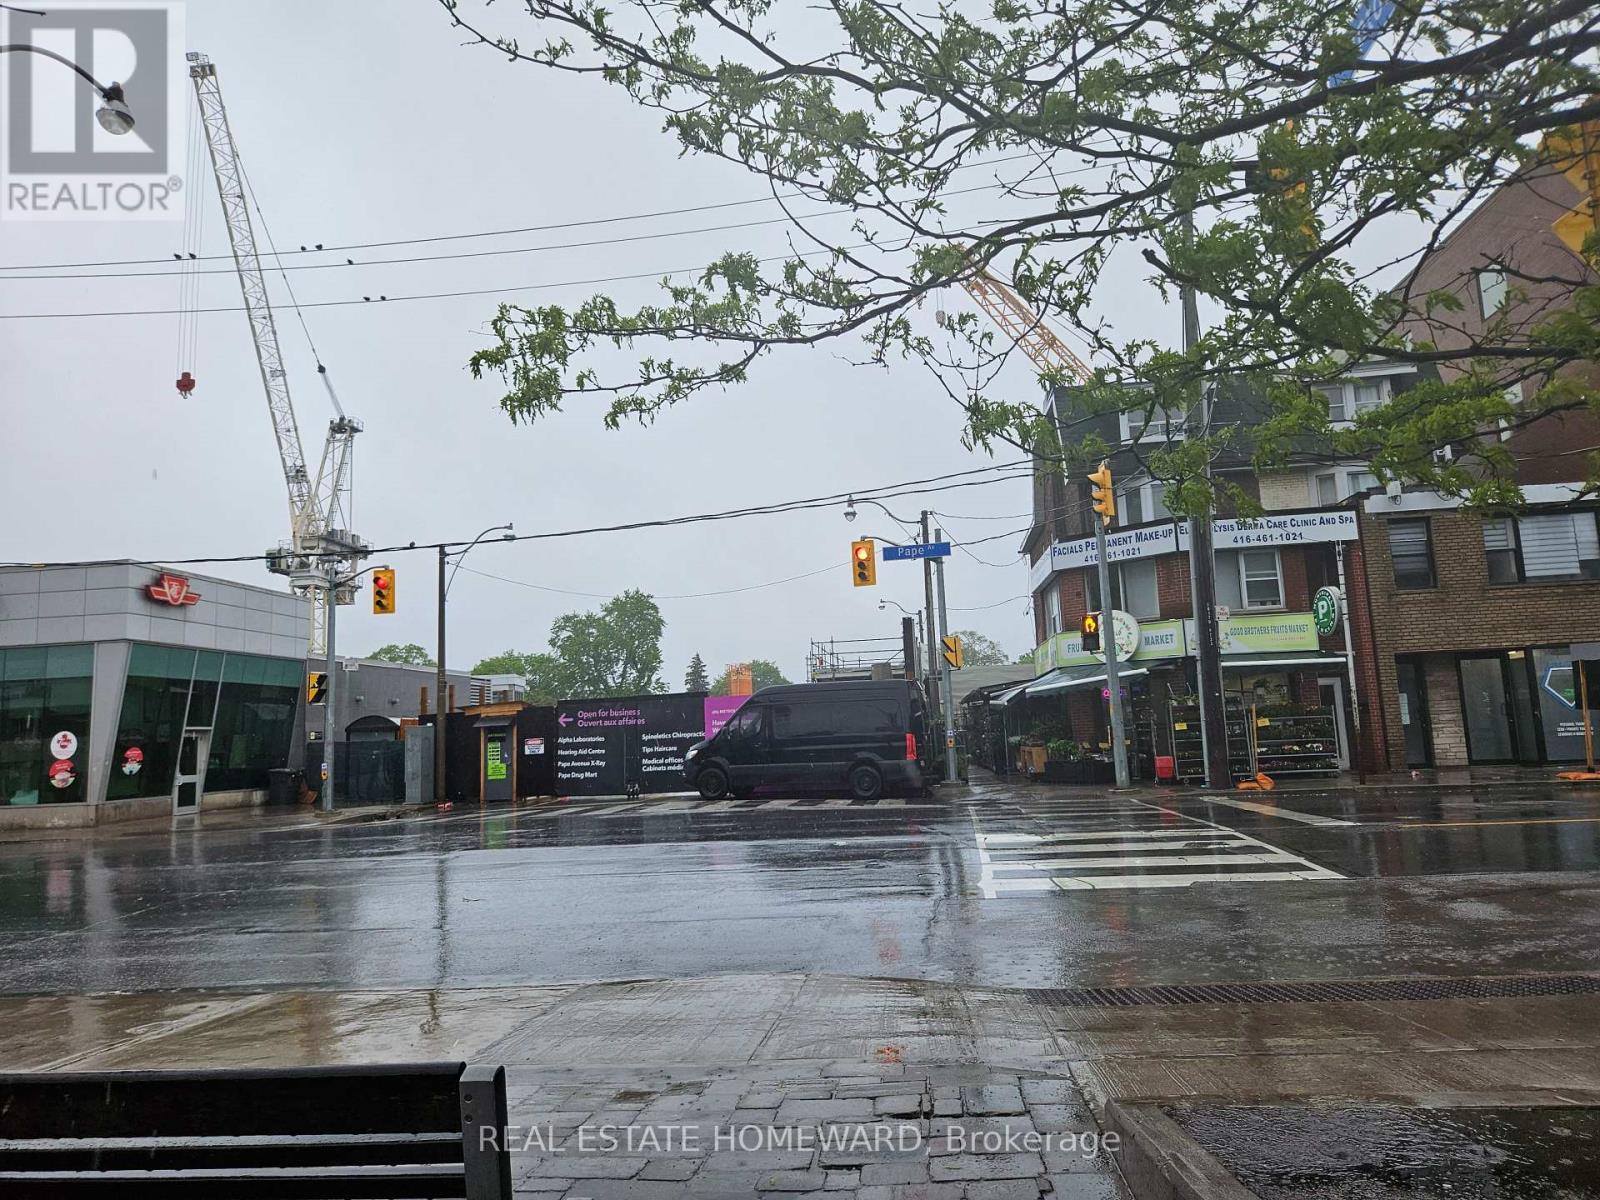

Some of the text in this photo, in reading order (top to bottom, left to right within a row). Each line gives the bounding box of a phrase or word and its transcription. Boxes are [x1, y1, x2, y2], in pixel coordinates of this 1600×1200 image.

[1052, 544, 1084, 558] FACIALS
[1084, 535, 1133, 552] PEANENT
[1134, 527, 1174, 544] MAKE-UP
[1179, 523, 1235, 536] ELLYSIS
[1266, 519, 1288, 529] CARE
[1289, 517, 1318, 528] CLINIC
[1318, 515, 1336, 526] AND
[1338, 514, 1355, 525] SPA
[1232, 532, 1304, 544] 416-461-1021
[897, 546, 926, 559] Pape
[1084, 547, 1141, 562] 41661-1021
[1317, 600, 1329, 620] P
[1229, 627, 1244, 637] GOOD
[1244, 626, 1270, 636] BROTHERS
[1288, 623, 1309, 633] MARKET
[1067, 633, 1174, 654] FRU MARKET
[577, 707, 641, 720] Open for business
[577, 717, 646, 728] Ouvert aux affaires
[557, 735, 606, 745] Alpha Laboratories
[672, 729, 706, 740] Chiropractic
[557, 748, 606, 758] Hearing Aid Centre
[641, 745, 678, 755] Tips Haircare
[557, 759, 606, 769] Pape Avenue X-Ray
[641, 756, 684, 766] Medical offices
[641, 764, 667, 773] Cabinets
[557, 771, 598, 780] Pape Drug Mart
